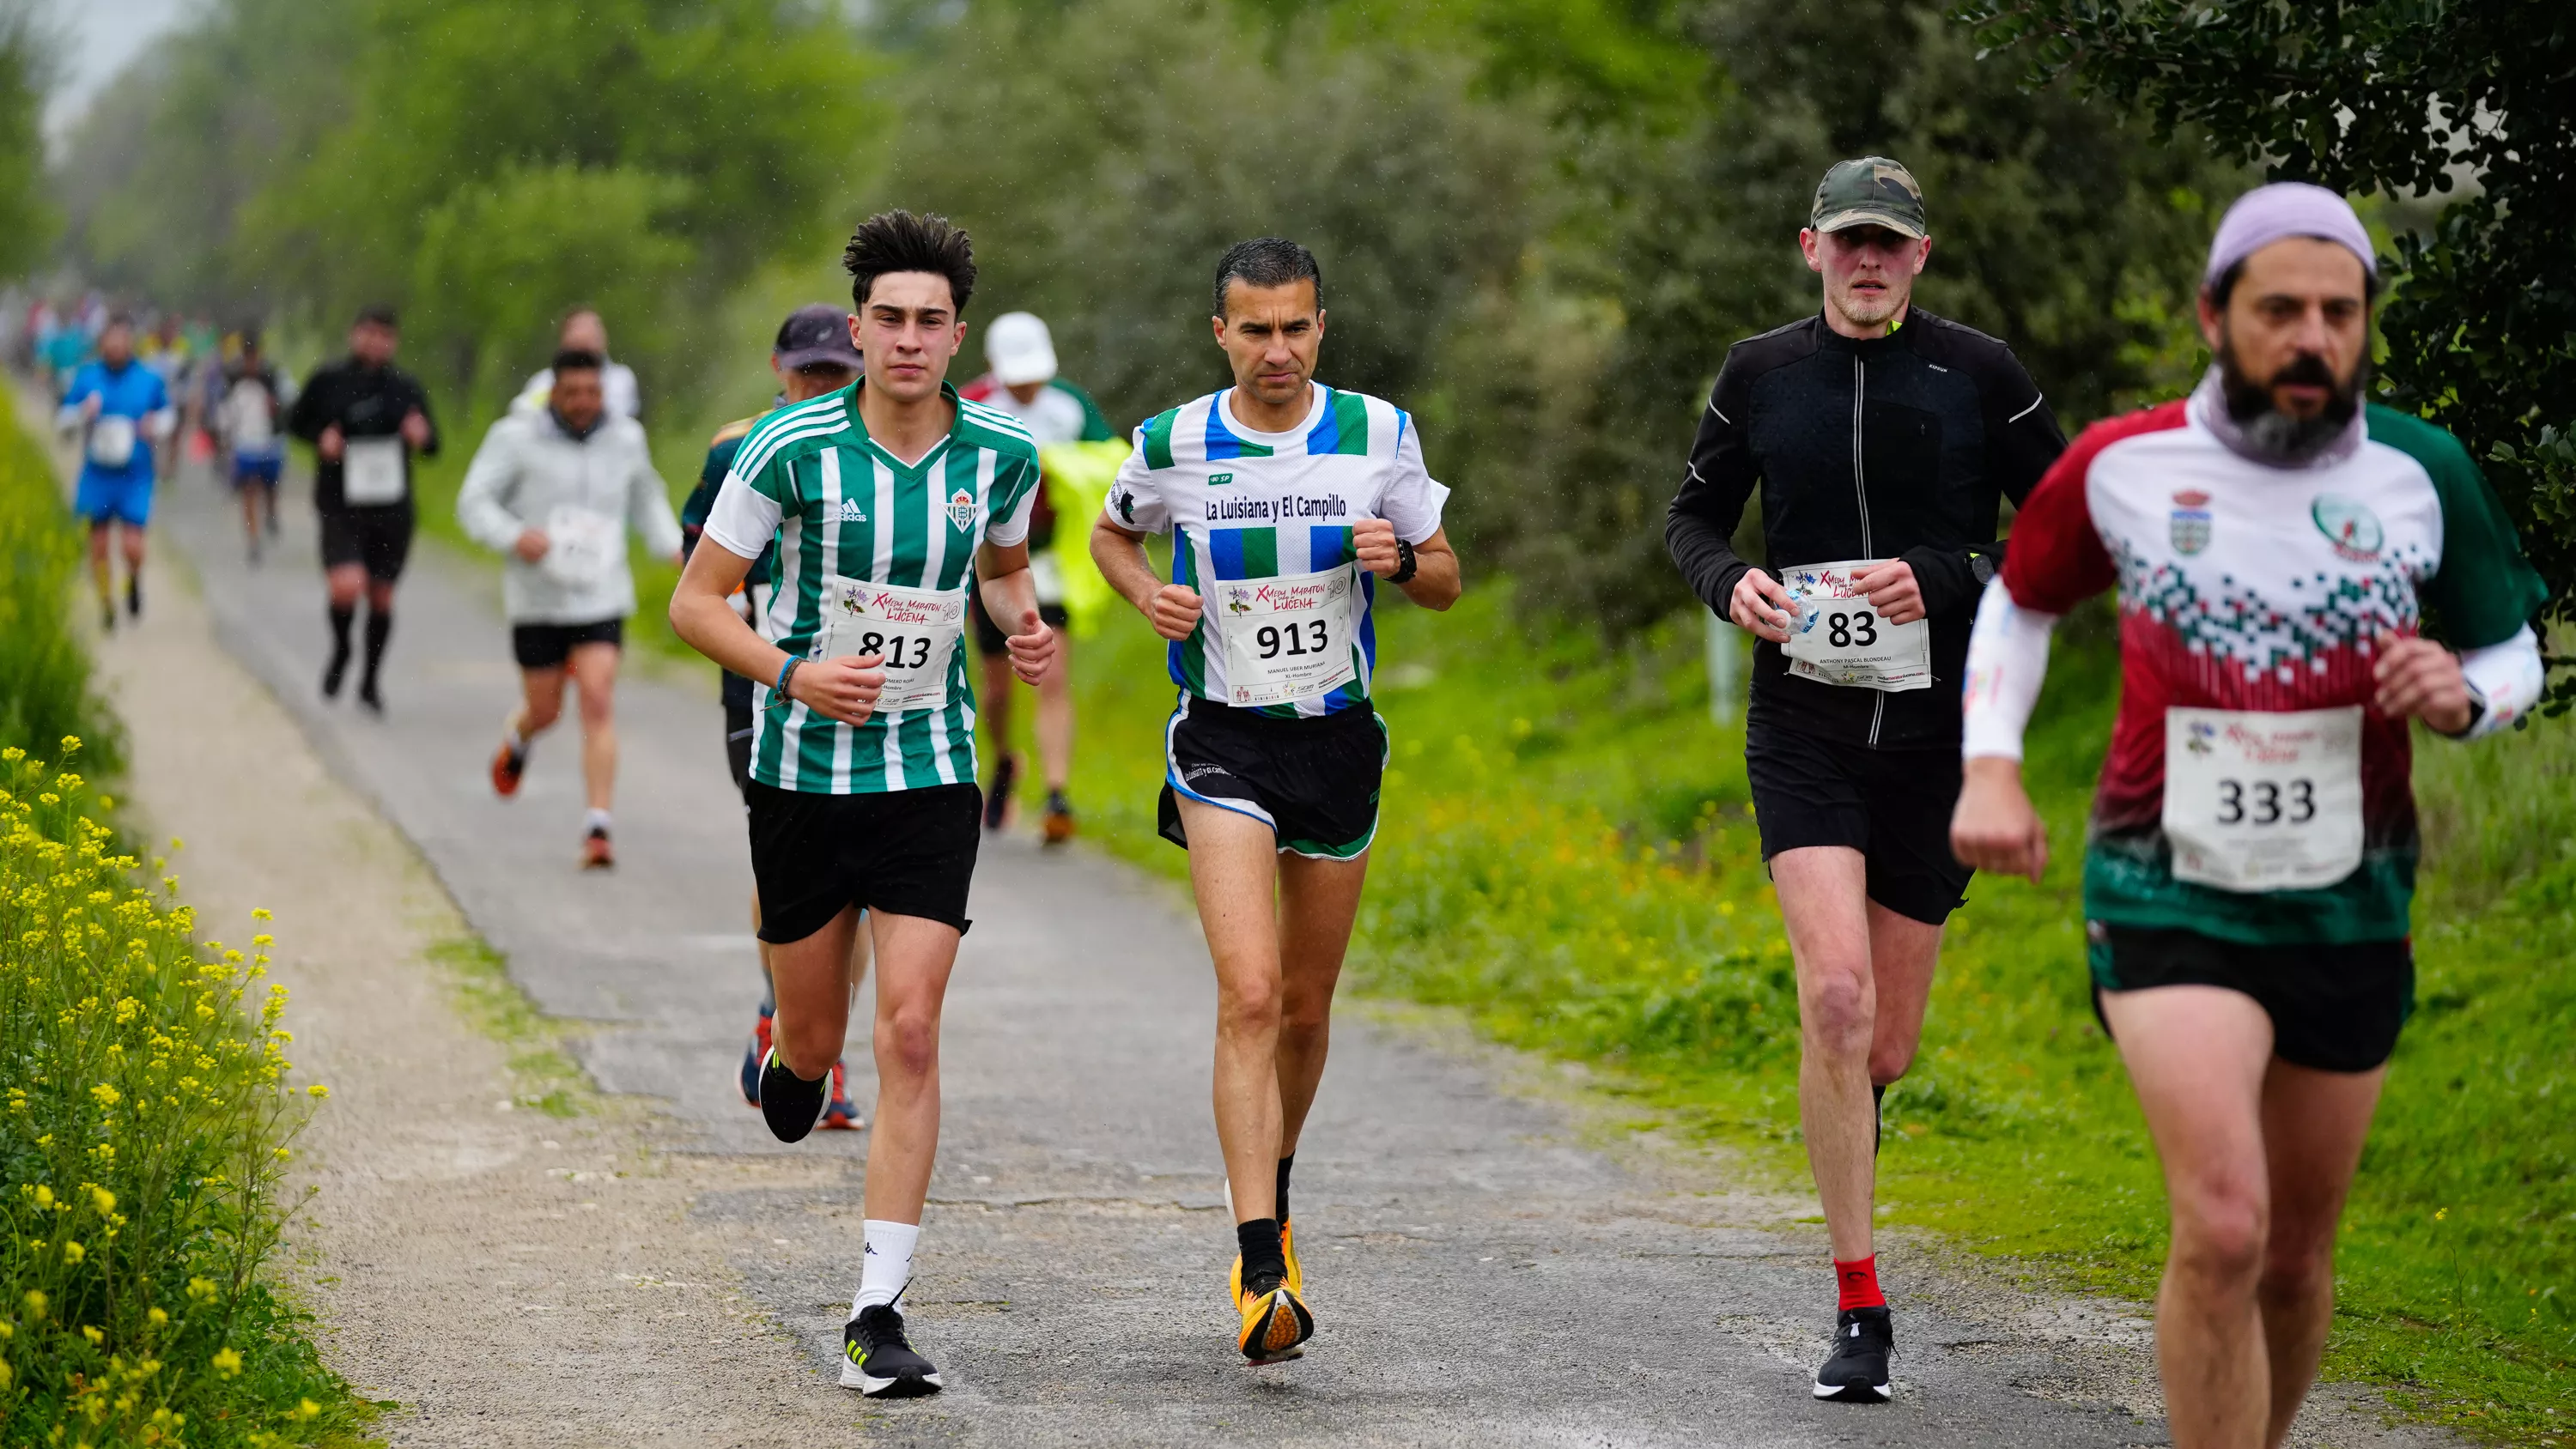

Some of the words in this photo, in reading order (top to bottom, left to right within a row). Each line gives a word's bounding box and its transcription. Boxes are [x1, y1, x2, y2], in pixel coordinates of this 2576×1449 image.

[833, 512, 866, 522] adidas
[1206, 501, 1218, 520] La
[1221, 496, 1268, 519] Luisiana
[1273, 500, 1279, 523] y
[1283, 495, 1293, 517] El
[1297, 494, 1346, 521] Campillo
[886, 608, 930, 624] LUCENA
[1274, 597, 1318, 610] LUCENA
[1257, 619, 1328, 658] 913
[1828, 611, 1877, 647] 83
[859, 632, 931, 669] 813
[2218, 777, 2317, 825] 333
